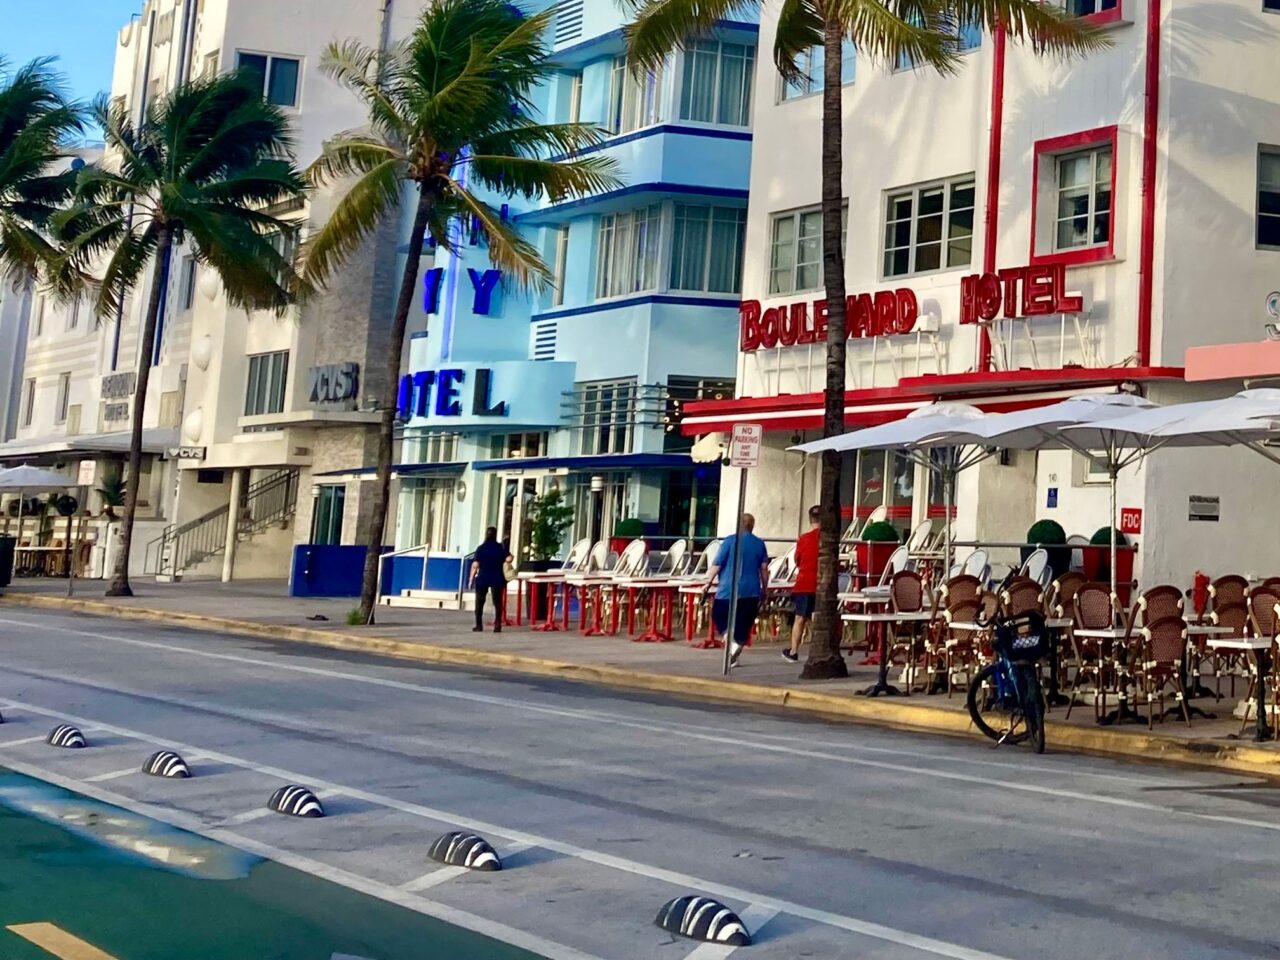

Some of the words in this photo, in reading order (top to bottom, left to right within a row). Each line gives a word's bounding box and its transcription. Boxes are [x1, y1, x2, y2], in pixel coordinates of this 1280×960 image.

[959, 263, 1084, 325] HOTEL
[317, 362, 359, 402] CVS
[397, 369, 505, 417] OTEL
[180, 448, 202, 458] CVS
[1122, 513, 1140, 528] FDC
